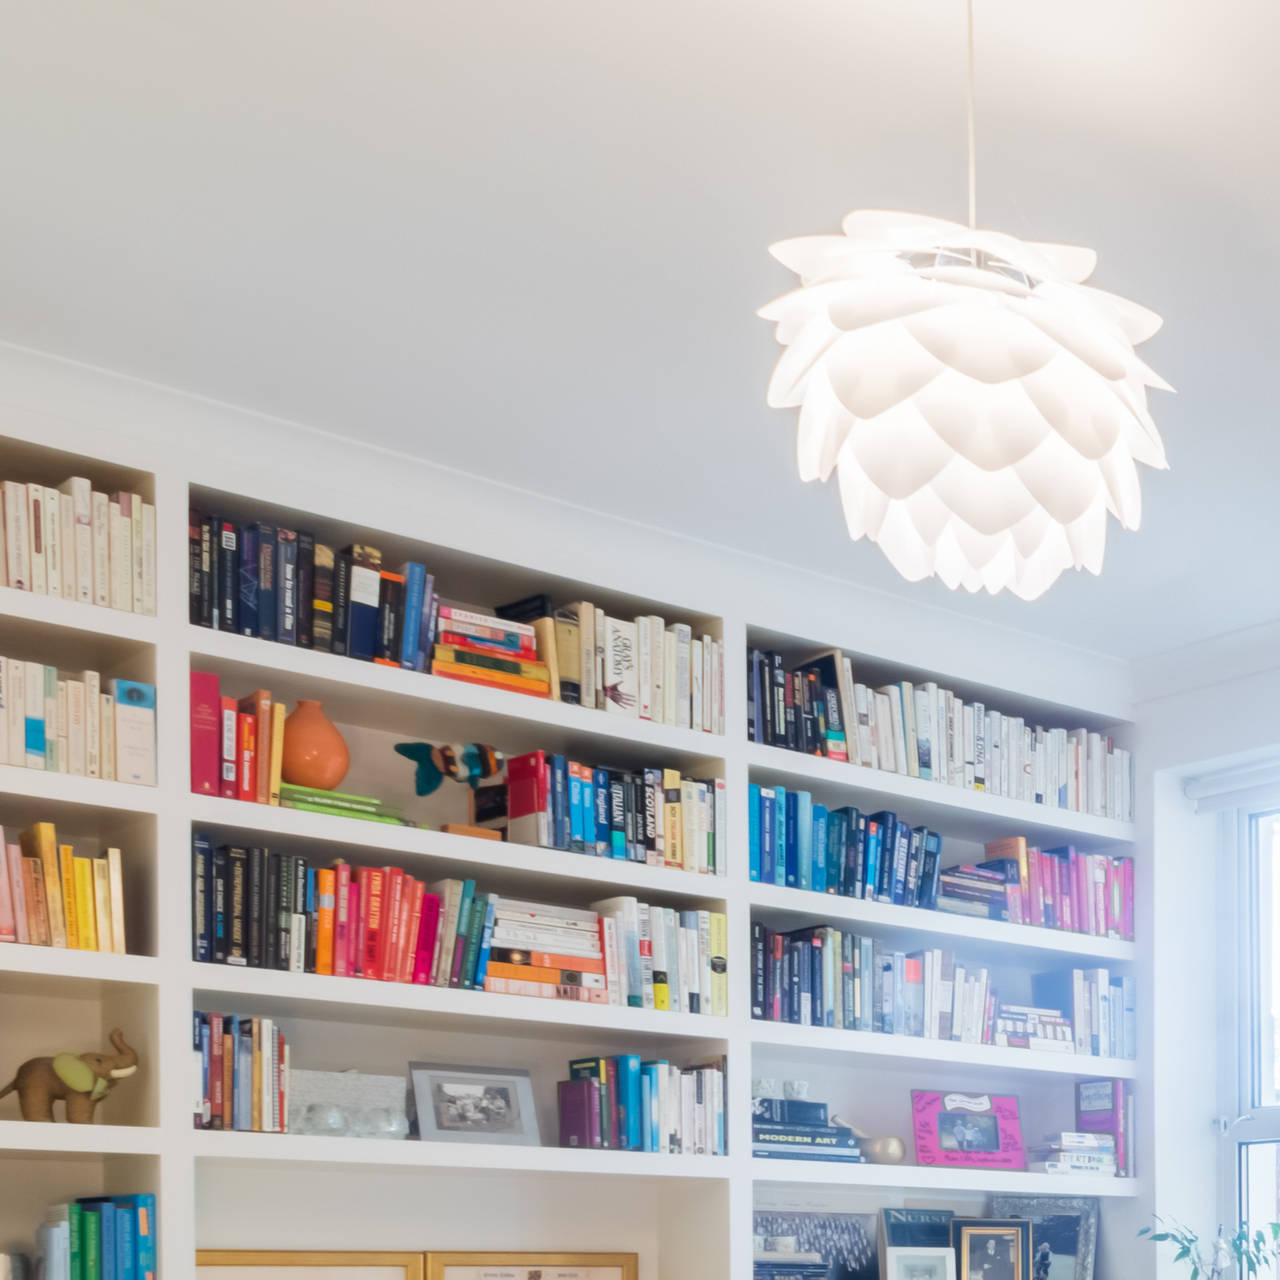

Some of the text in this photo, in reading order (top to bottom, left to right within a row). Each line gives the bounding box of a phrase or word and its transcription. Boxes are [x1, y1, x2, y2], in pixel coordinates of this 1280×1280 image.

[596, 787, 608, 825] England
[613, 789, 625, 823] ITALIAN
[644, 786, 656, 838] SCOTLAND
[371, 871, 382, 894] LYNDA
[368, 896, 381, 930] GRATTON
[759, 1133, 838, 1145] MODERN ART
